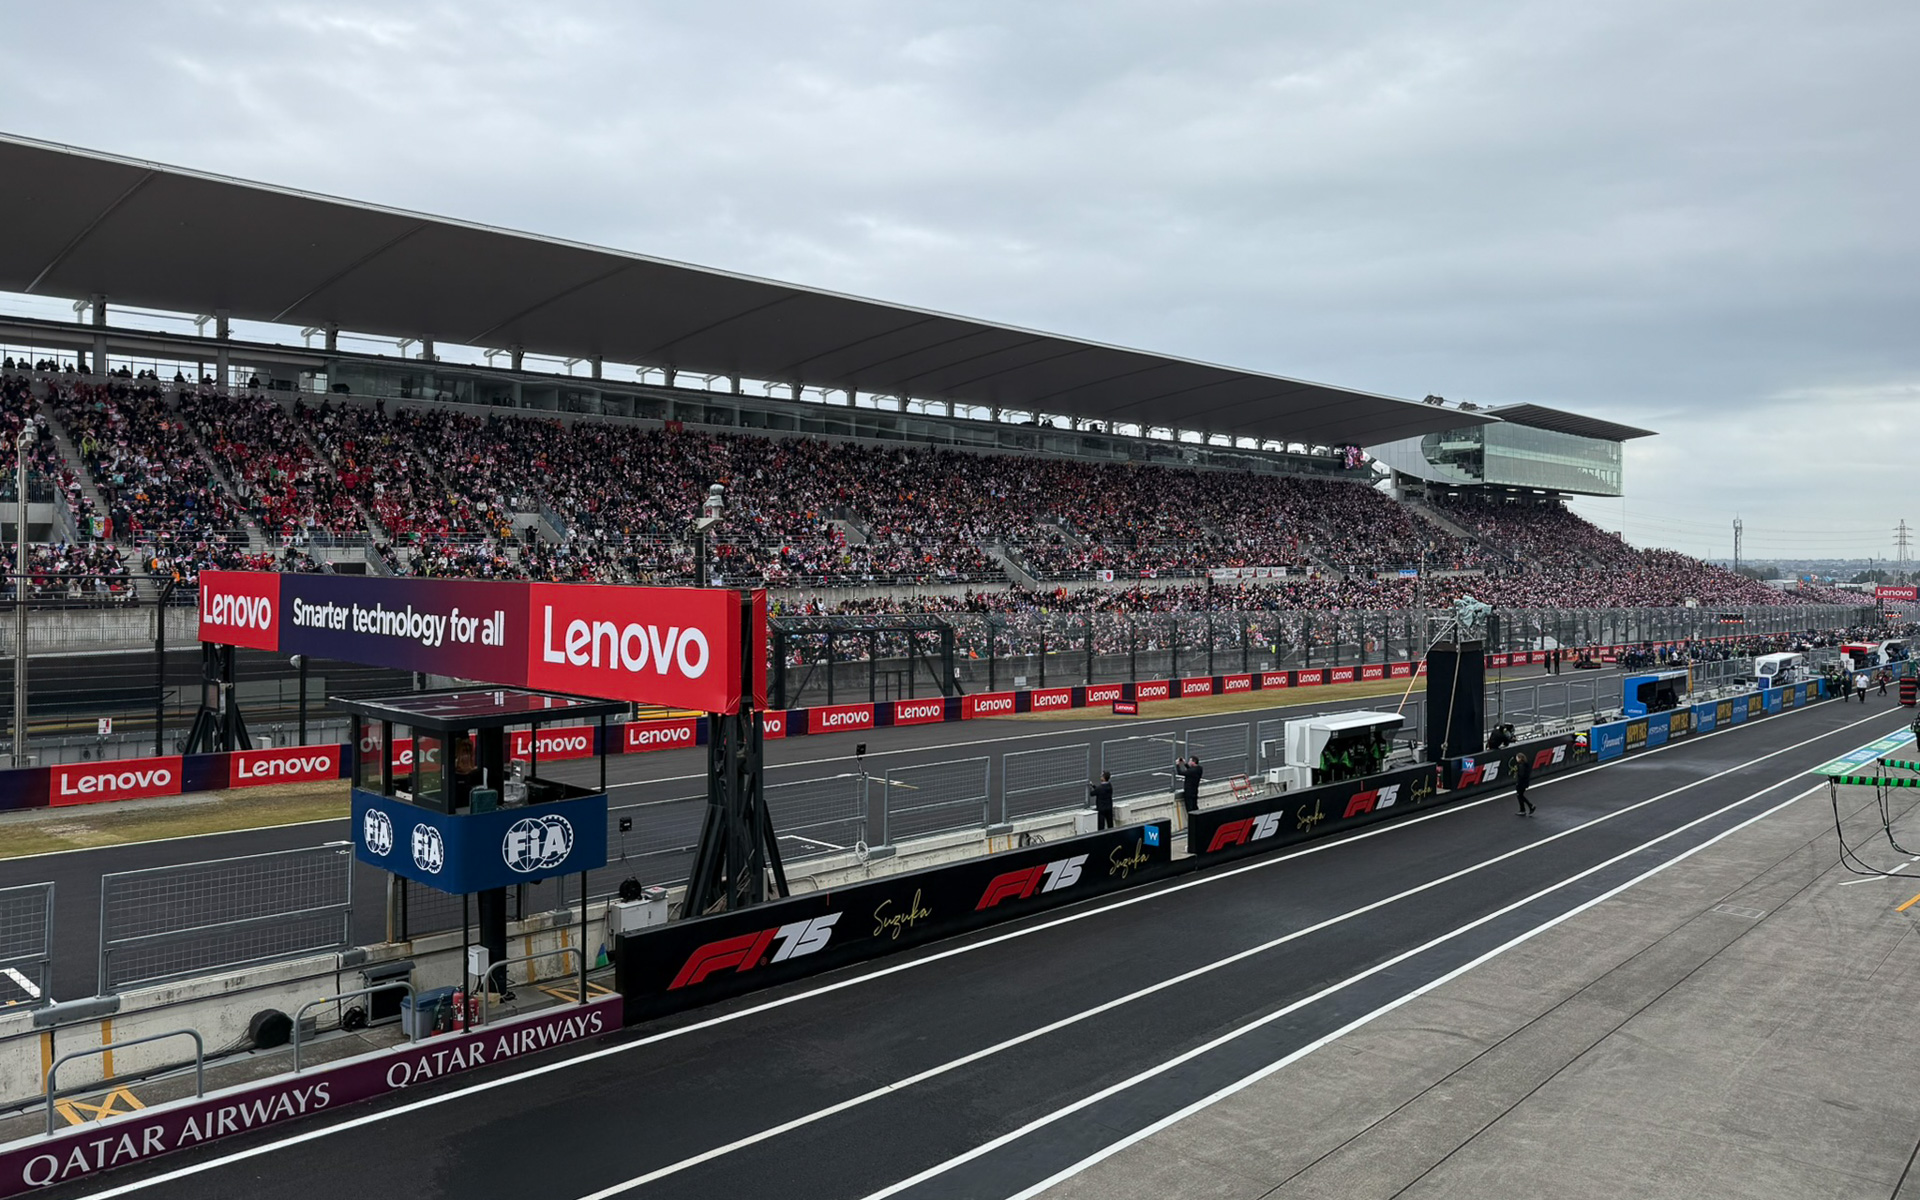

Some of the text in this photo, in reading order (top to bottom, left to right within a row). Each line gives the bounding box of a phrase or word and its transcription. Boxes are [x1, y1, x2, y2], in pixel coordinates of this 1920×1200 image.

[1877, 588, 1914, 597] Lenovo
[203, 585, 272, 630] Lenovo
[293, 598, 505, 648] Smarter technology for all
[543, 605, 710, 679] Lenovo
[1332, 669, 1353, 680] Lenovo
[1362, 667, 1382, 677] Lenovo
[1391, 665, 1409, 675] Lenovo
[1225, 679, 1250, 690] Lenovo
[1263, 674, 1287, 686] Lenovo
[1299, 673, 1321, 684] Lenovo
[1137, 684, 1167, 697] Lenovo
[1183, 681, 1210, 693] Lenovo
[1034, 694, 1069, 707] Lenovo
[1088, 688, 1120, 702] Lenovo
[897, 705, 941, 719] Lenovo
[974, 698, 1012, 712] Lenovo
[822, 711, 870, 727] Lenovo
[630, 727, 691, 746] Lenovo
[517, 736, 587, 755] Lenovo
[238, 756, 331, 779] Lenovo
[61, 769, 172, 796] Lenovo
[1148, 831, 1159, 841] W
[1109, 837, 1150, 879] Suzuka
[873, 888, 933, 940] Suzuka
[386, 1011, 604, 1088] QATAR AIRWAYS
[22, 1082, 331, 1187] QATAR AIRWAYS
